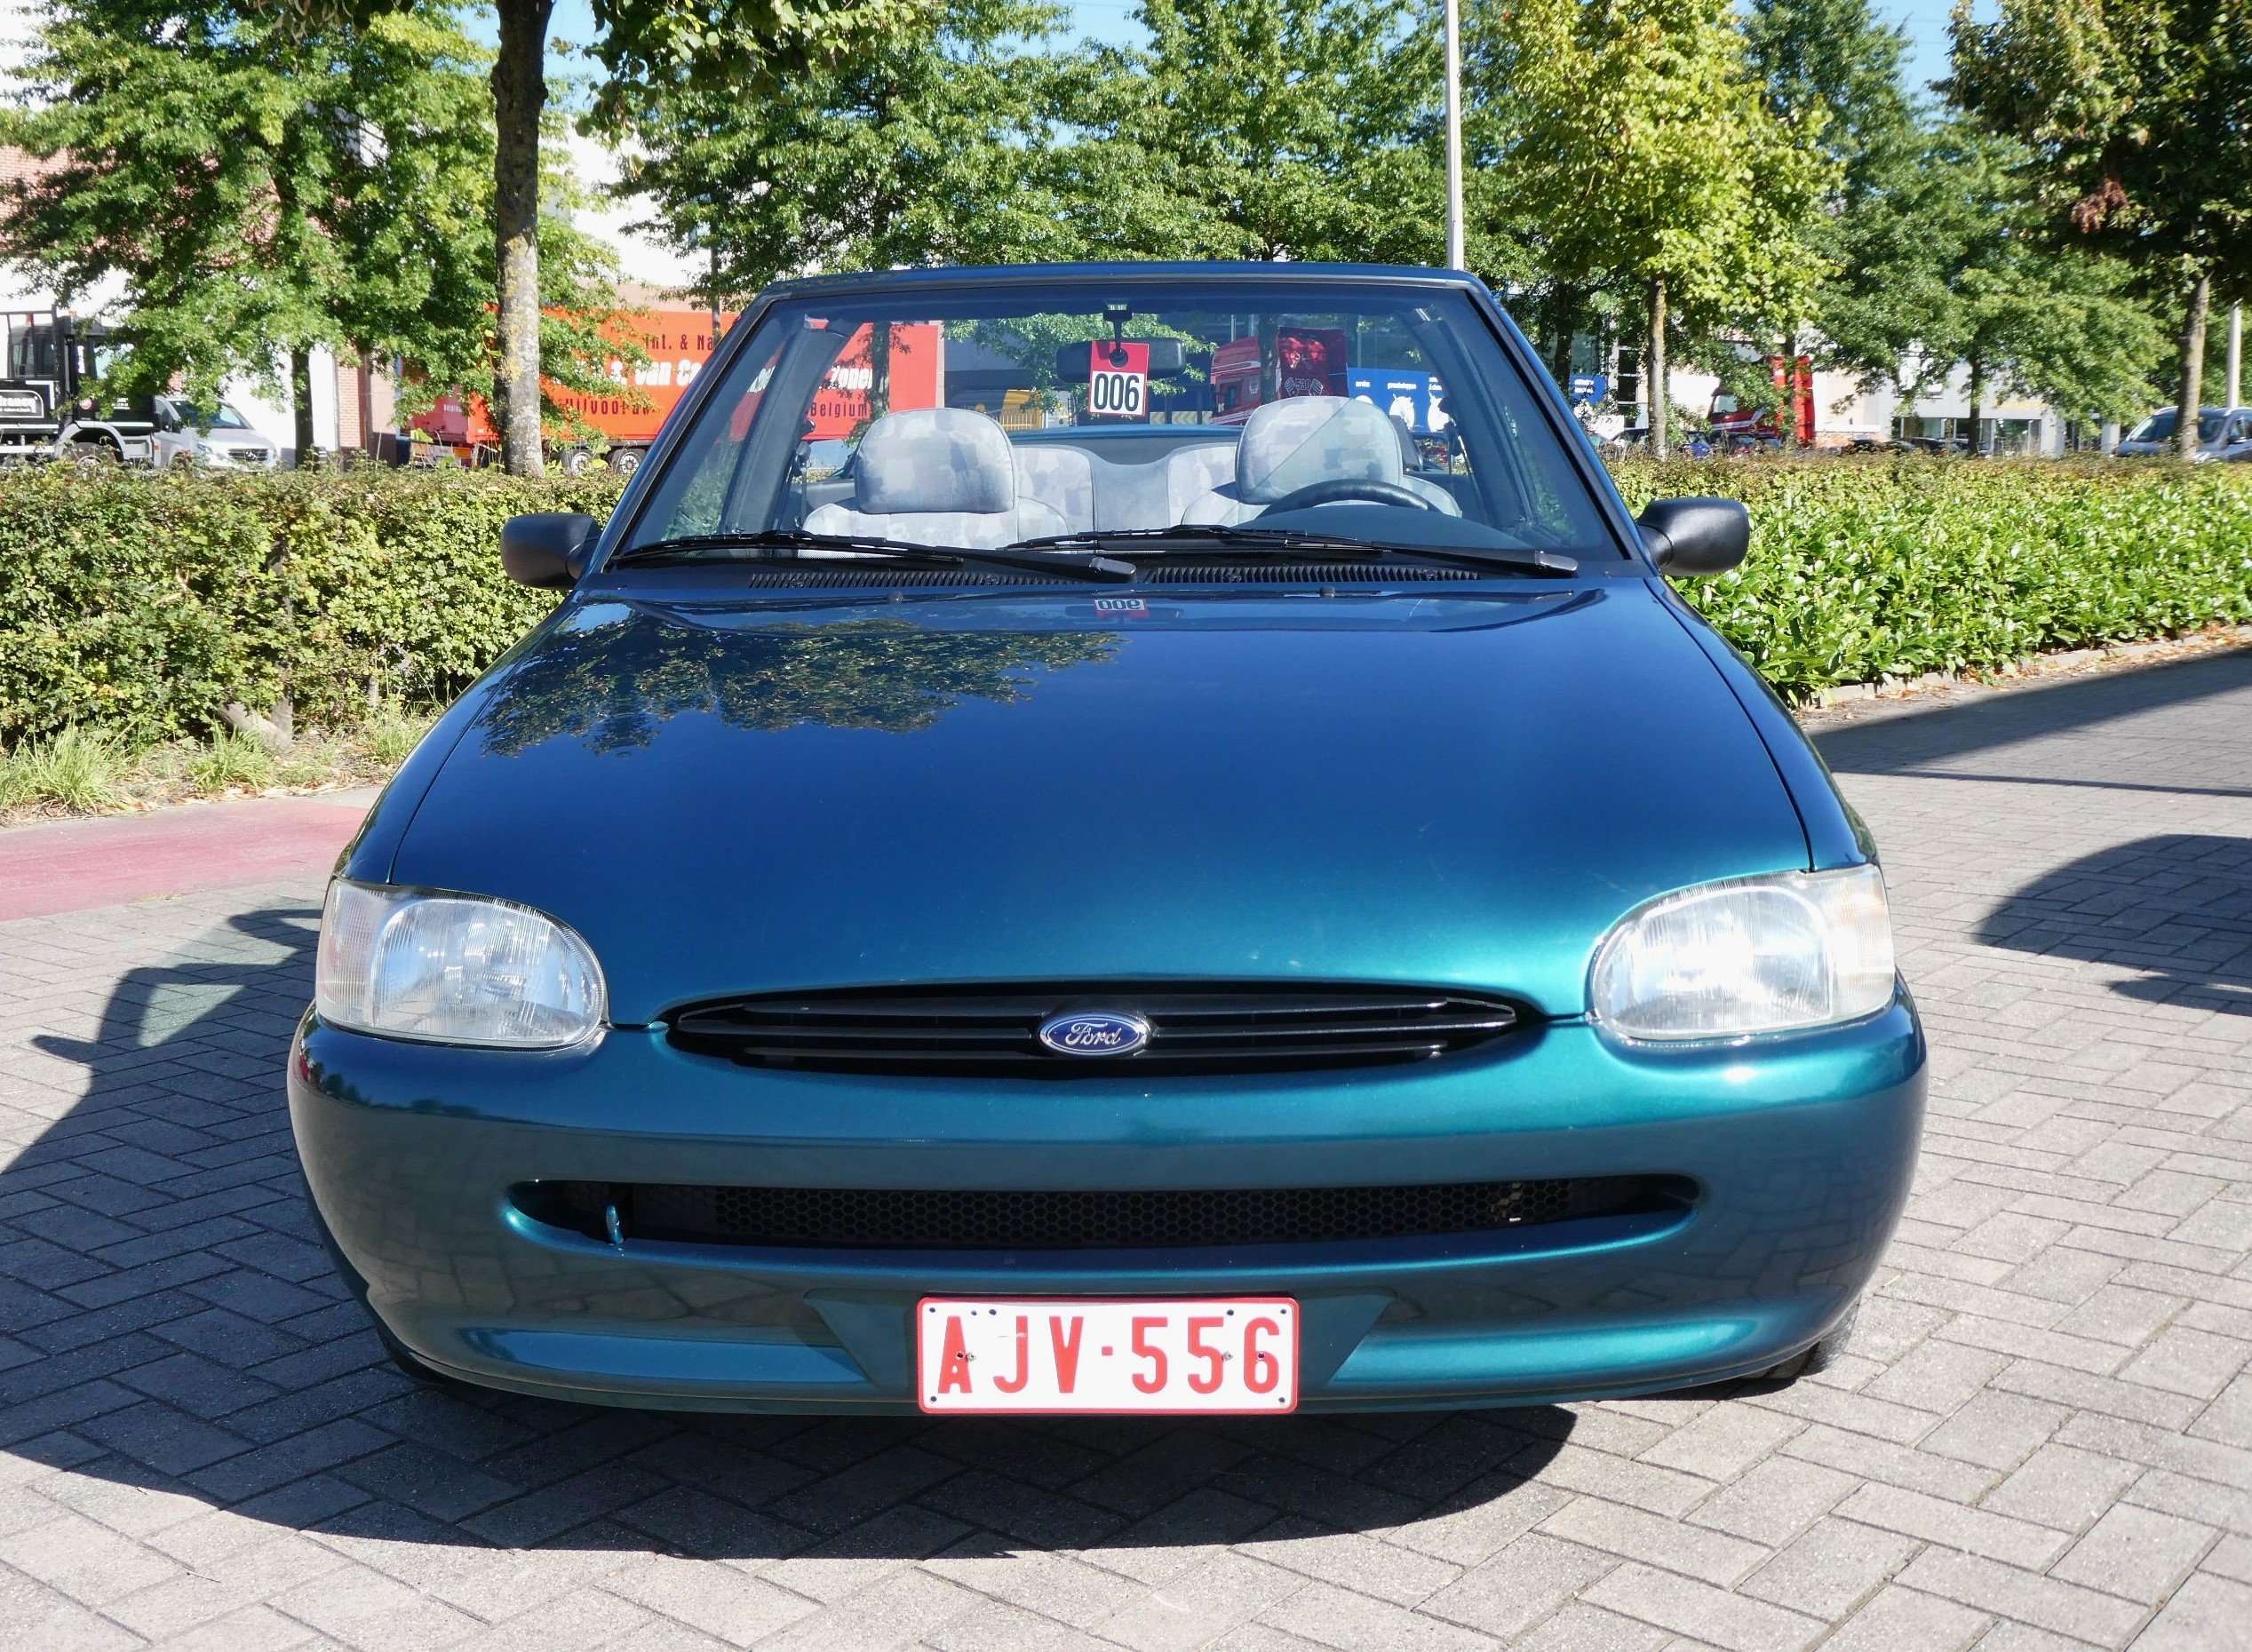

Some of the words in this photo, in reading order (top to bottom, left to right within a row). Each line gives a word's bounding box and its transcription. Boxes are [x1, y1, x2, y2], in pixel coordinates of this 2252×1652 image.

[680, 334, 688, 350] &
[1094, 373, 1140, 411] 006
[810, 402, 867, 417] Belgium
[1065, 1022, 1122, 1045] Ford
